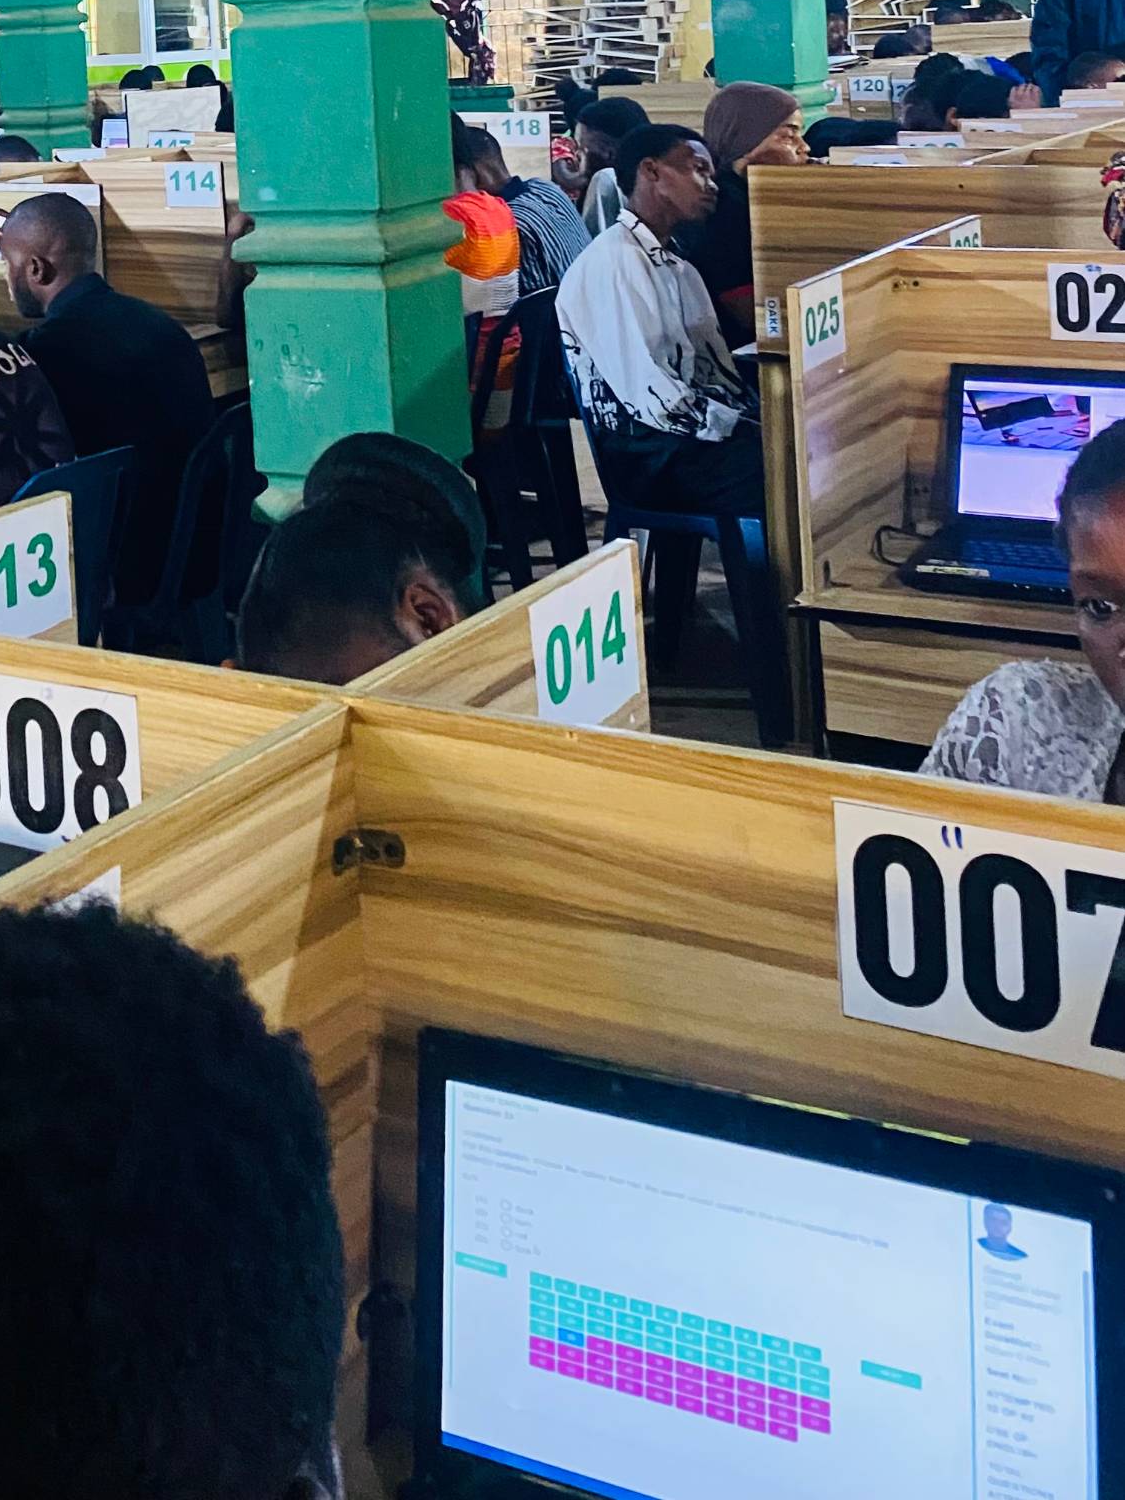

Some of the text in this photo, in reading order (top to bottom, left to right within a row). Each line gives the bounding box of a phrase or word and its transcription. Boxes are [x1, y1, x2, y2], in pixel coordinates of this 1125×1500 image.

[853, 78, 884, 92] 120
[502, 119, 541, 135] 118
[170, 170, 216, 191] 114
[805, 296, 840, 347] 025
[545, 589, 627, 705] 014
[853, 833, 1125, 1054] 007
